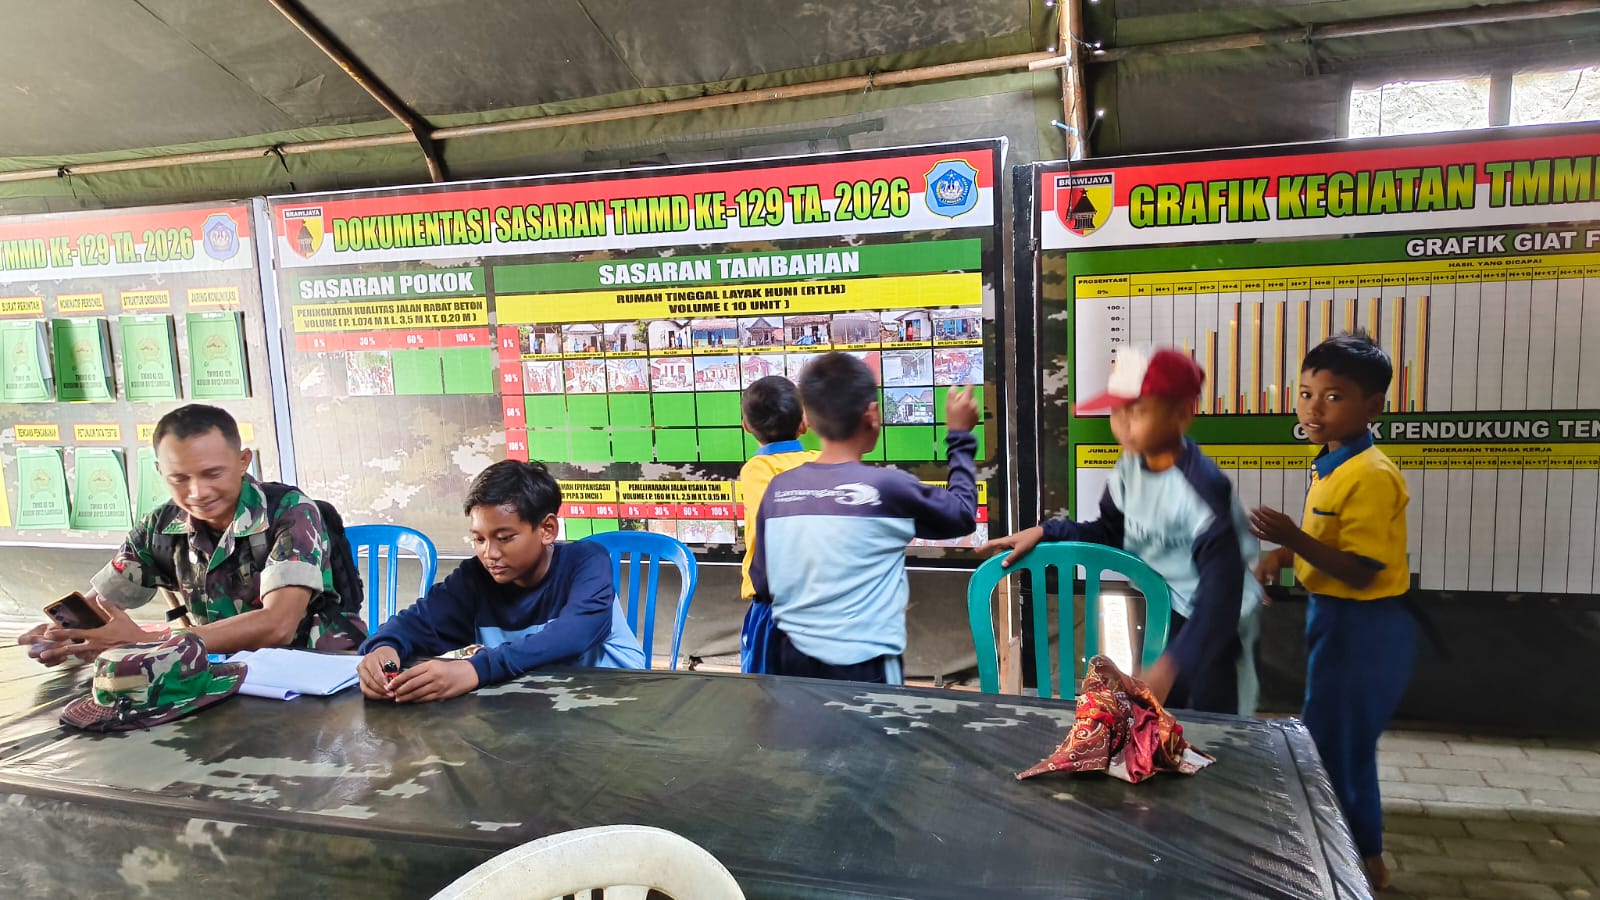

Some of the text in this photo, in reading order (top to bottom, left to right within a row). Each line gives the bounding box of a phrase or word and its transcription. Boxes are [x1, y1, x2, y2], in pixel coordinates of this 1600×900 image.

[1058, 175, 1111, 187] BRAWIJAYA
[1129, 154, 1600, 228] GRAFIK KEGIATAN TMM
[332, 178, 910, 252] DOKUMENTASI SASARAN TMMD KE-129 TA. 2026
[49, 233, 111, 267] KE-129
[111, 231, 141, 264] TA.
[143, 227, 195, 261] 2026
[1406, 234, 1507, 257] GRAFIK
[1514, 231, 1577, 252] GIAT
[599, 251, 860, 286] SASARAN TAMBAHAN
[300, 271, 475, 300] SASARAN POKOK
[1078, 277, 1128, 285] PROSENTASE
[617, 293, 662, 304] RUMAH
[665, 291, 720, 302] TINGGAL
[722, 288, 762, 299] LAYAK
[765, 287, 798, 297] HUNI
[297, 300, 483, 318] PENINGKATAN KUALITAS JALAN RABAT BETON
[669, 302, 720, 314] VOLUME
[731, 301, 747, 311] 10
[750, 300, 781, 310] UNIT
[304, 318, 337, 329] VOLUME
[374, 316, 383, 325] M
[383, 316, 390, 325] X
[415, 314, 424, 324] M
[424, 314, 431, 323] X
[463, 313, 471, 322] M
[1390, 420, 1550, 439] PENDUKUNG
